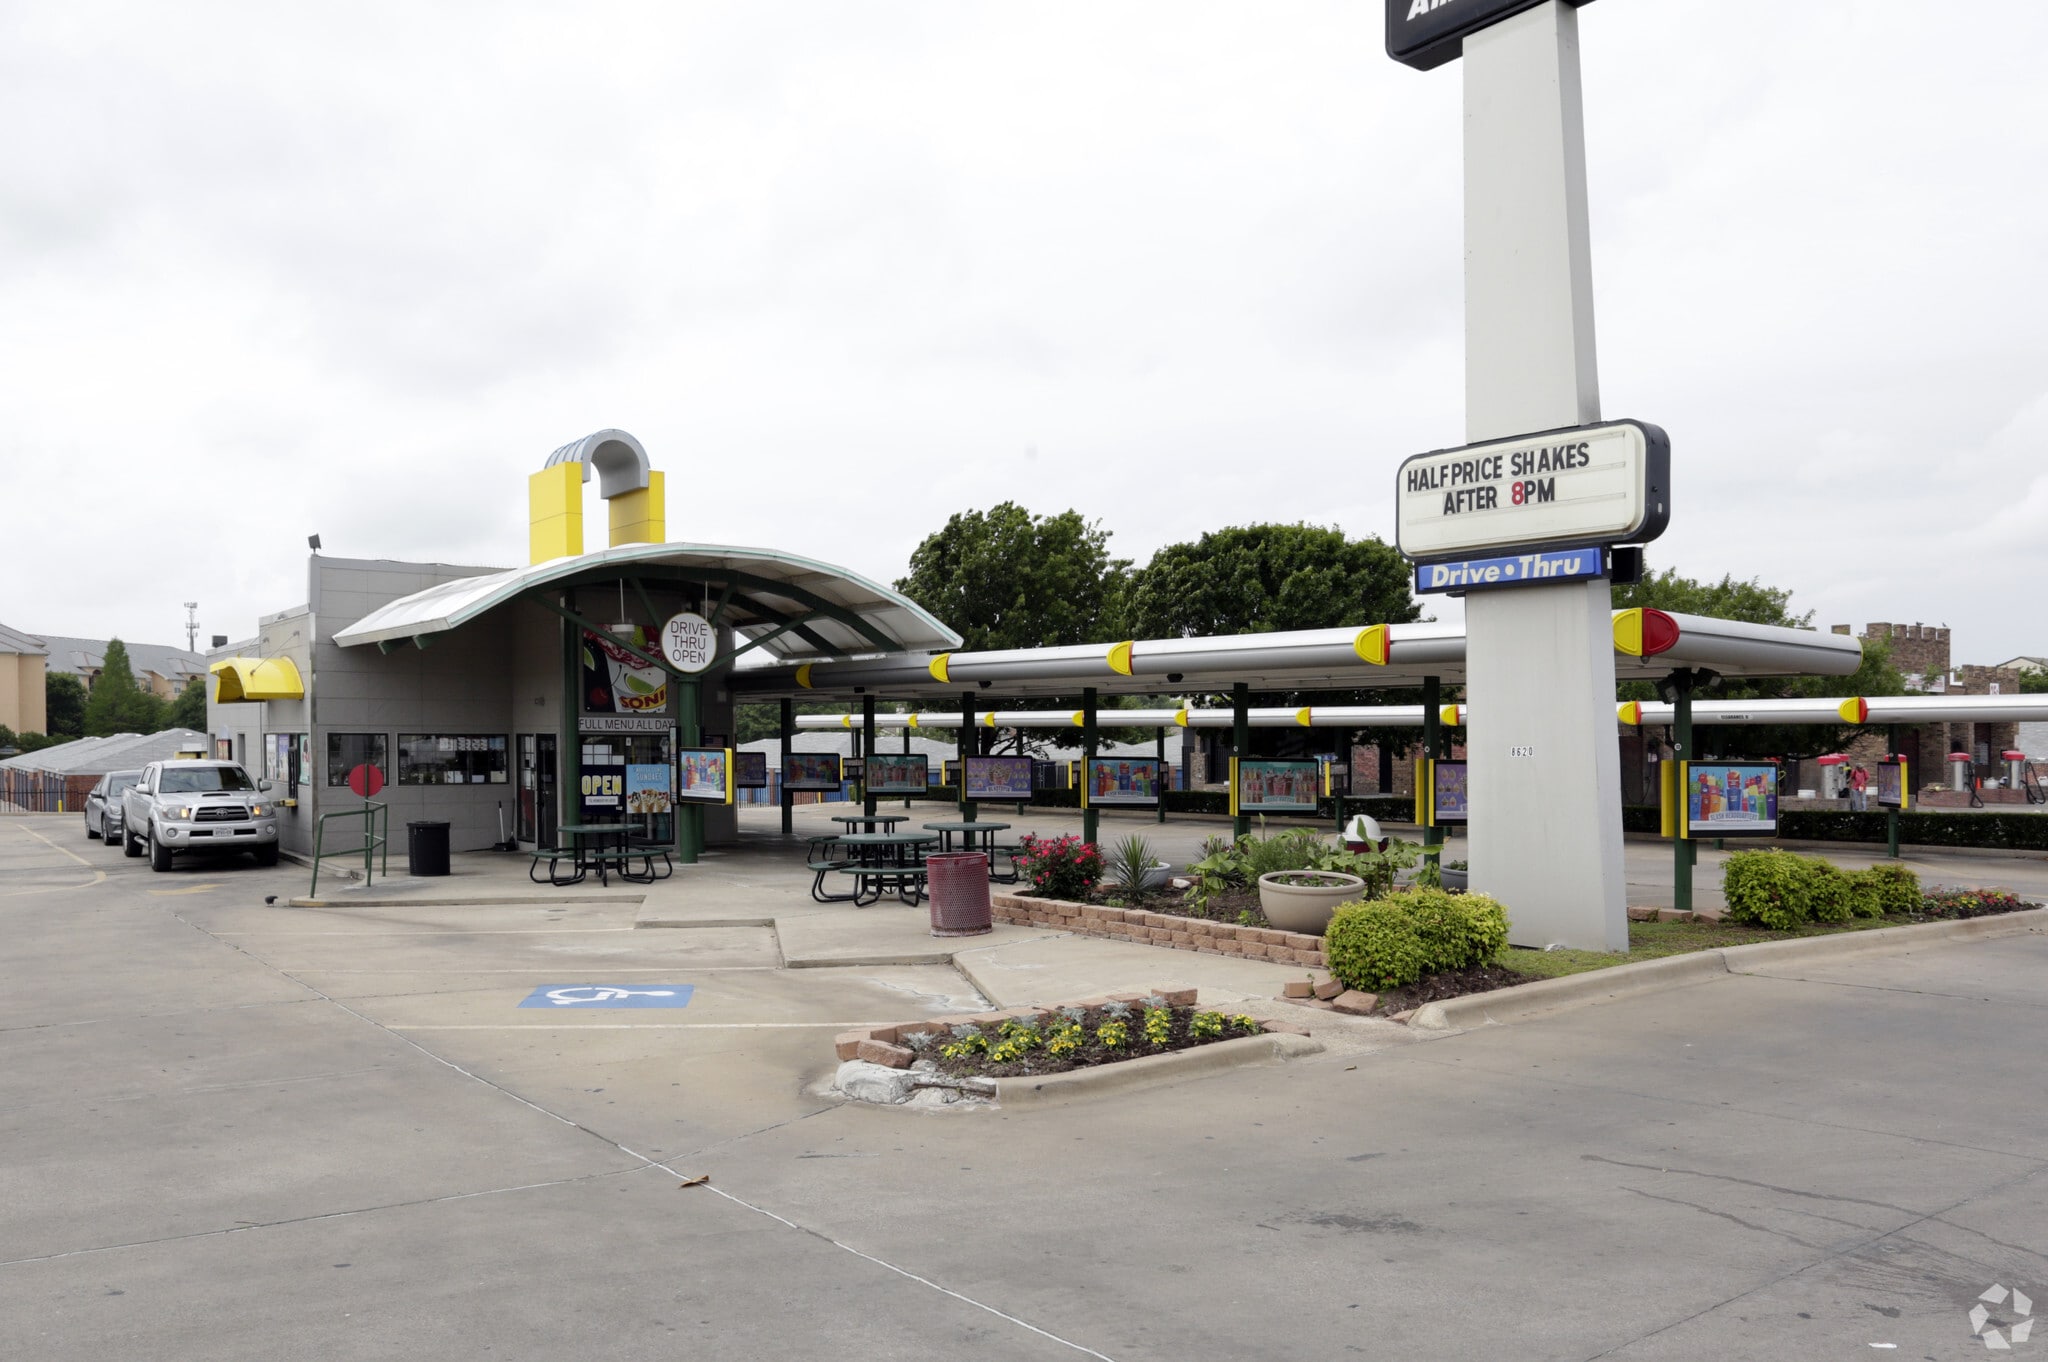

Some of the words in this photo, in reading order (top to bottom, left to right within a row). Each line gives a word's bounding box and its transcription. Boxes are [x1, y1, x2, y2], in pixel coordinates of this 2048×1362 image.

[1407, 466, 1448, 492] HALF
[1451, 455, 1503, 486] PRICE
[1511, 441, 1590, 477] SHAKES
[1443, 486, 1498, 515] AFTER
[1511, 477, 1556, 506] 8PM
[1431, 562, 1500, 588] Drive
[1518, 554, 1581, 578] Thru
[670, 620, 708, 636] DRIVE
[672, 635, 706, 650] THRU
[672, 649, 706, 664] OPEN
[579, 719, 603, 730] FULL
[605, 719, 634, 730] MENU
[636, 719, 654, 730] ALL
[655, 719, 674, 730] DAY
[1511, 746, 1533, 757] 8620
[581, 775, 622, 796] OPEN
